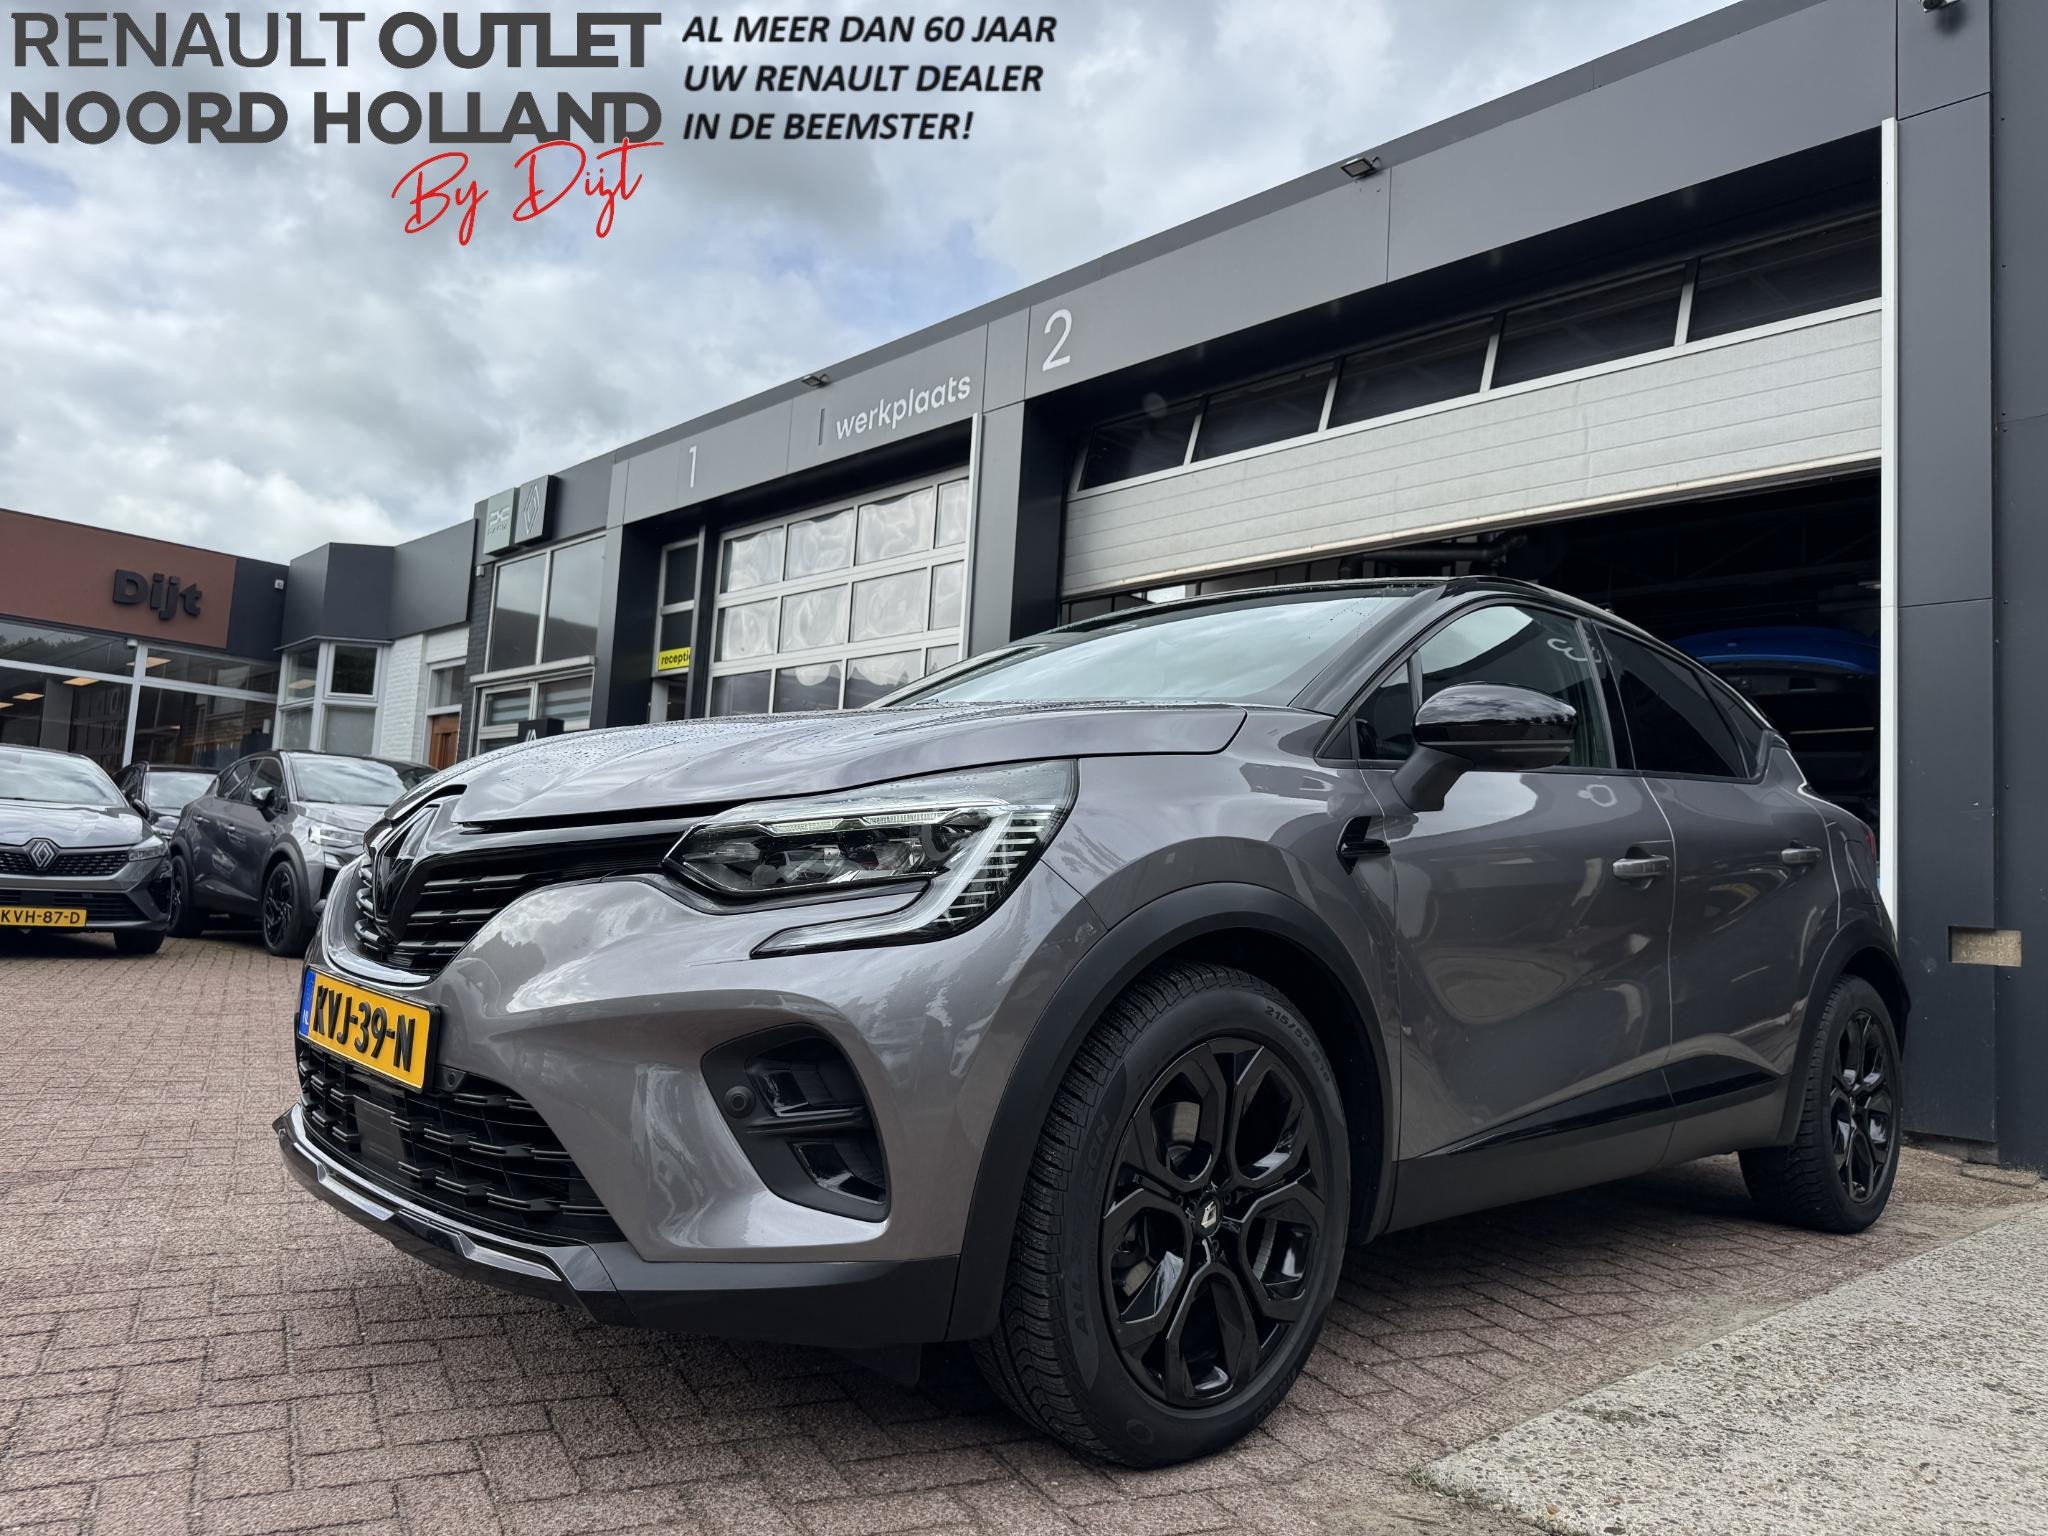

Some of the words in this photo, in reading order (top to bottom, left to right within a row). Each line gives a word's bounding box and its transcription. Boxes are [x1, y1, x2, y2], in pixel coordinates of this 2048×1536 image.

[1042, 309, 1072, 372] 2
[835, 375, 972, 440] werkplaats
[689, 444, 697, 488] 1
[112, 569, 203, 621] Dijt
[661, 649, 691, 665] recepti
[1, 909, 81, 924] KVH-87-D
[312, 984, 416, 1073] KVJ-39-N
